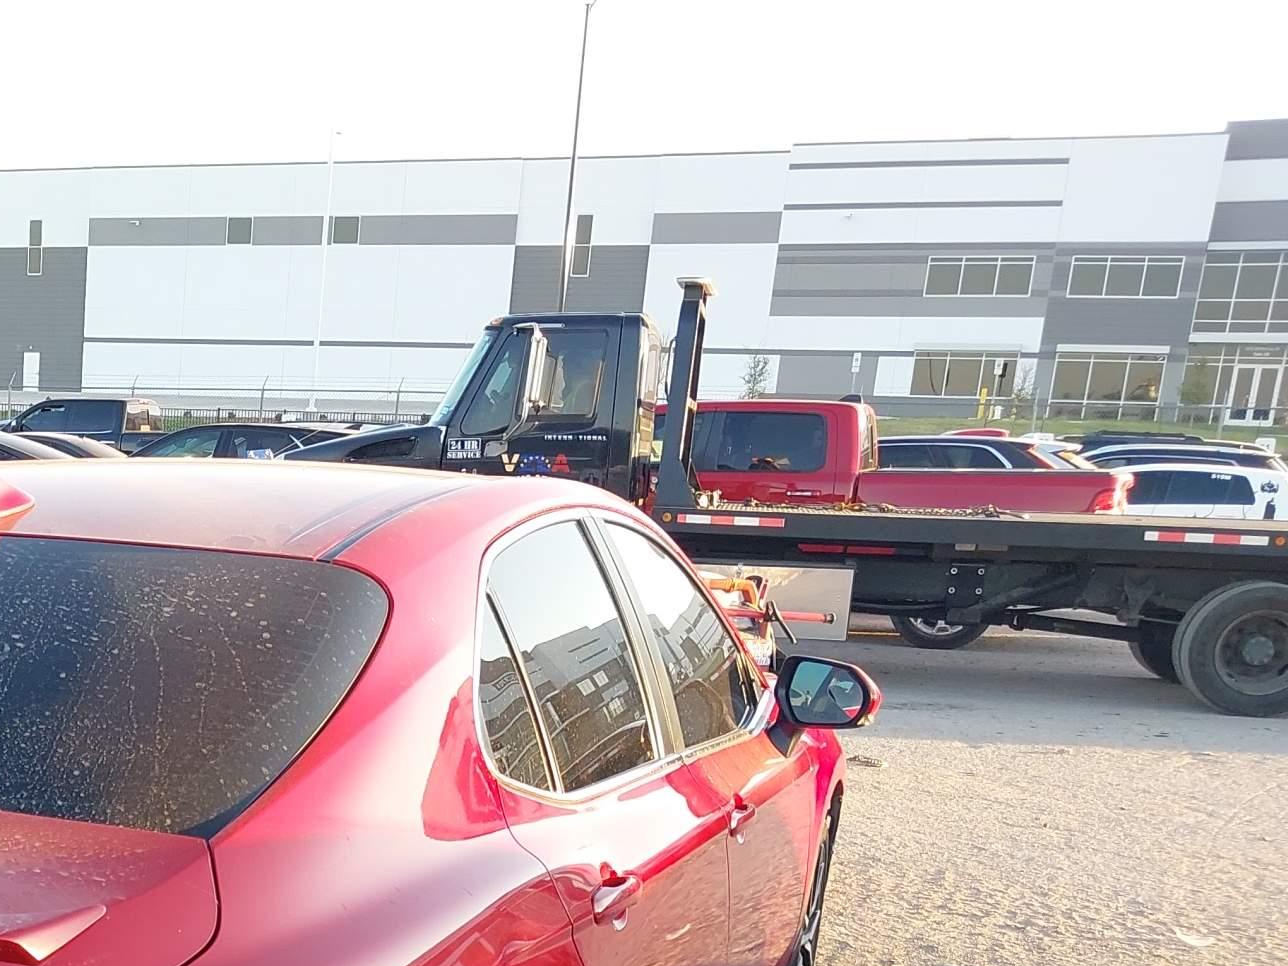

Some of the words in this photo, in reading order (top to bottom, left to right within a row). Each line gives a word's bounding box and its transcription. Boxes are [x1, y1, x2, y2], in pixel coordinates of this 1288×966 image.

[450, 440, 461, 450] 24
[464, 440, 478, 450] HR
[446, 451, 481, 459] SERVICE
